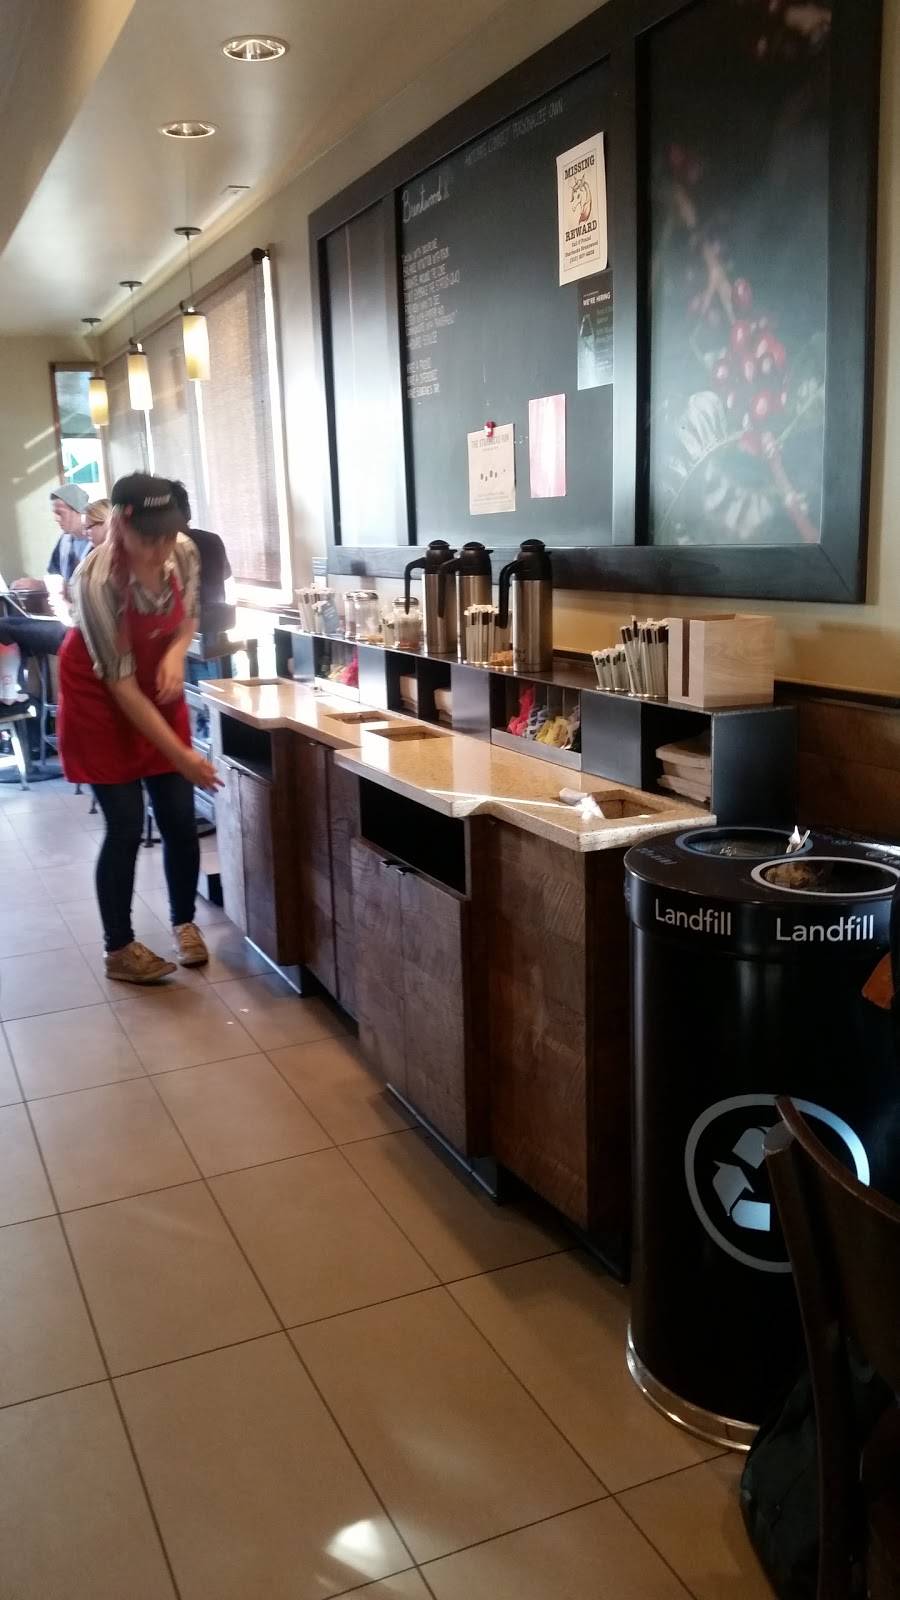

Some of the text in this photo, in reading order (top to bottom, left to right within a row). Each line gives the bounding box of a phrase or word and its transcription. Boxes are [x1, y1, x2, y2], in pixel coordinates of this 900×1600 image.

[564, 155, 595, 180] MISSING
[565, 220, 598, 242] REWARD
[655, 898, 732, 936] Landfill
[776, 914, 874, 942] Landfill
